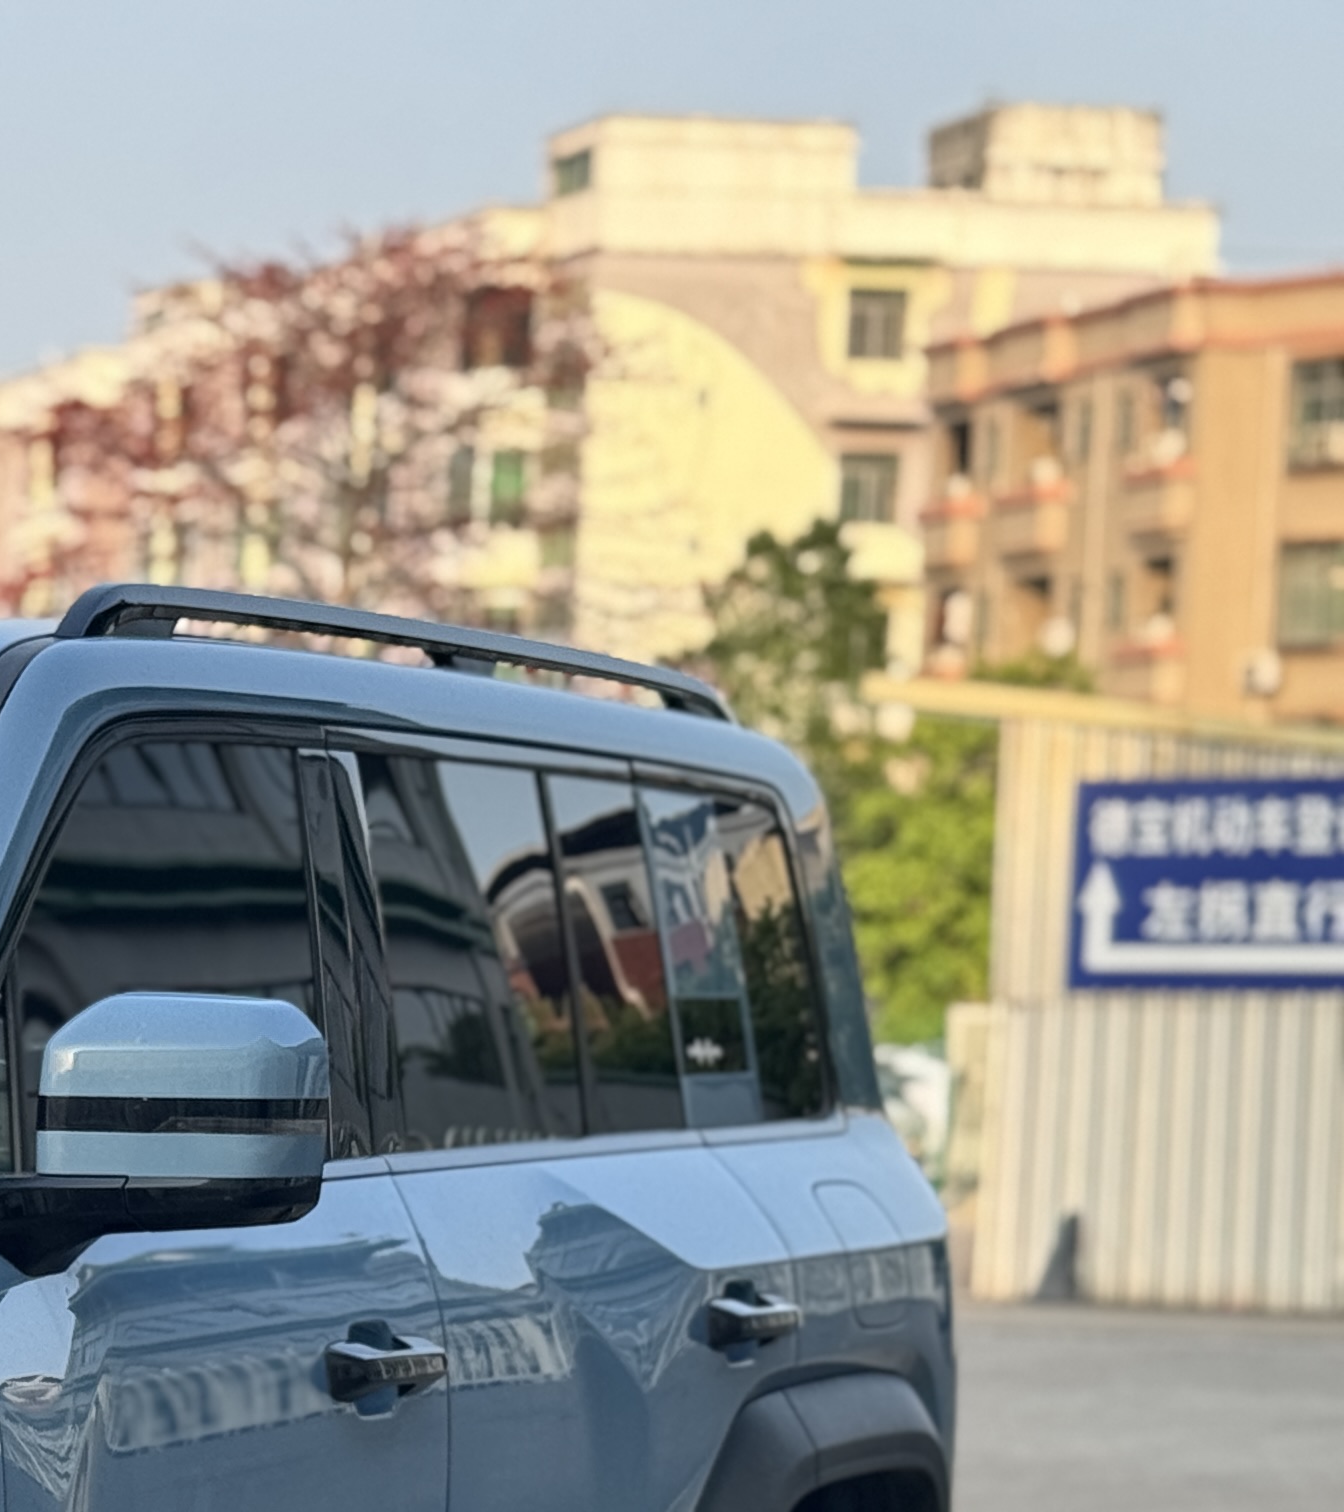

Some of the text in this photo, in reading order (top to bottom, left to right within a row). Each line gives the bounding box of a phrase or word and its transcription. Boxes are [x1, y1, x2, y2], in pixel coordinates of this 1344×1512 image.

[1089, 793, 1344, 859] 德宝机动车登
